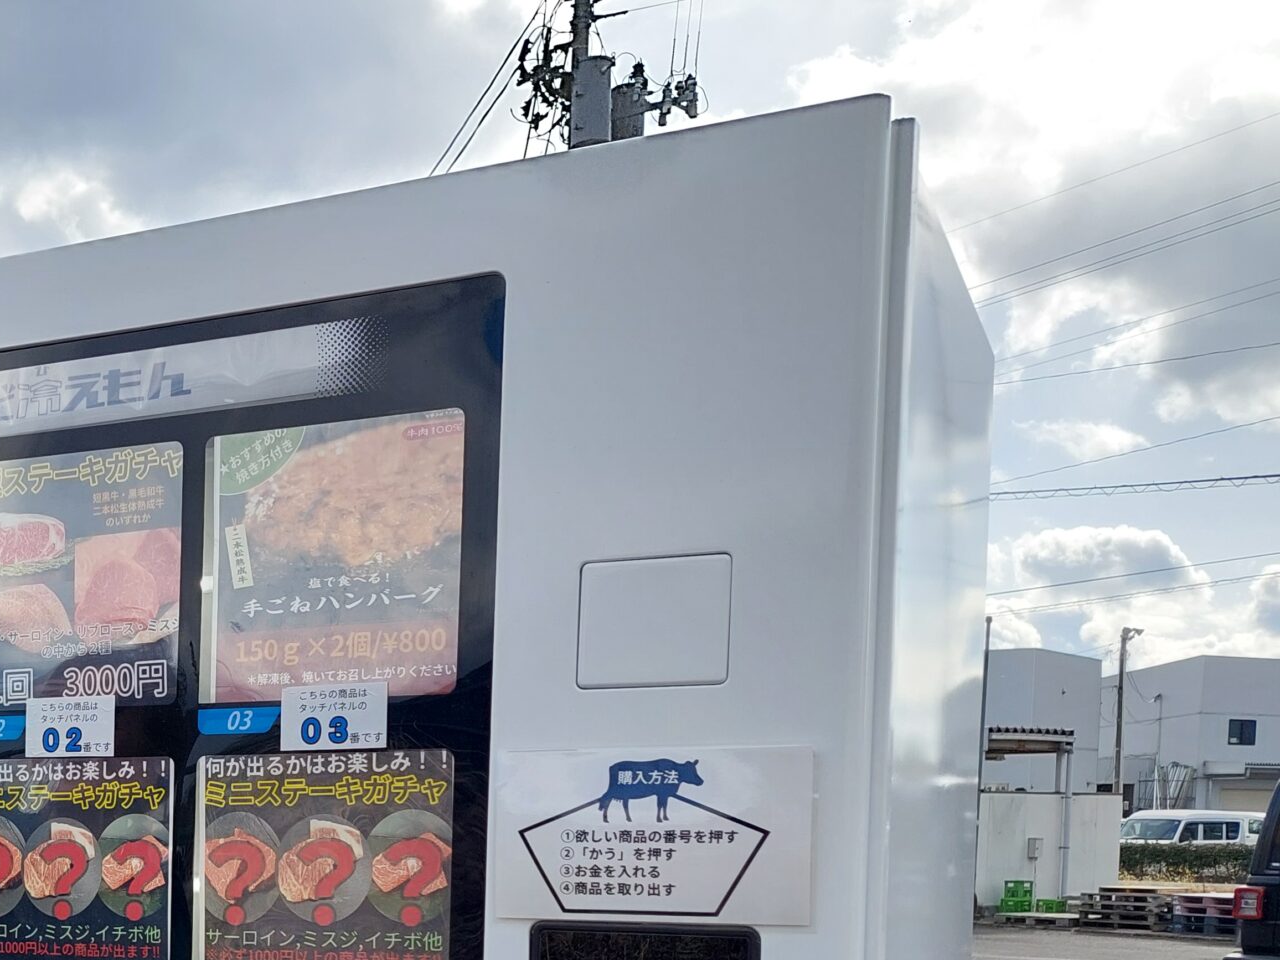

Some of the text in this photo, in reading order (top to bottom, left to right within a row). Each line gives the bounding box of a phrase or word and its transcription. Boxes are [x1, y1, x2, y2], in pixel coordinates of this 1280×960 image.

[105, 513, 151, 527] のいずれか
[241, 583, 445, 617] 手ごねハンバーグ
[63, 659, 167, 699] 3000円
[299, 688, 368, 700] こちらの商品は
[41, 702, 98, 712] こちらの商品は
[299, 700, 367, 713] タッチパネルの
[40, 713, 98, 723] タッチパネルの
[227, 711, 252, 731] 03
[617, 769, 680, 785] 購入方法
[205, 774, 448, 807] ミニステーキガチャ
